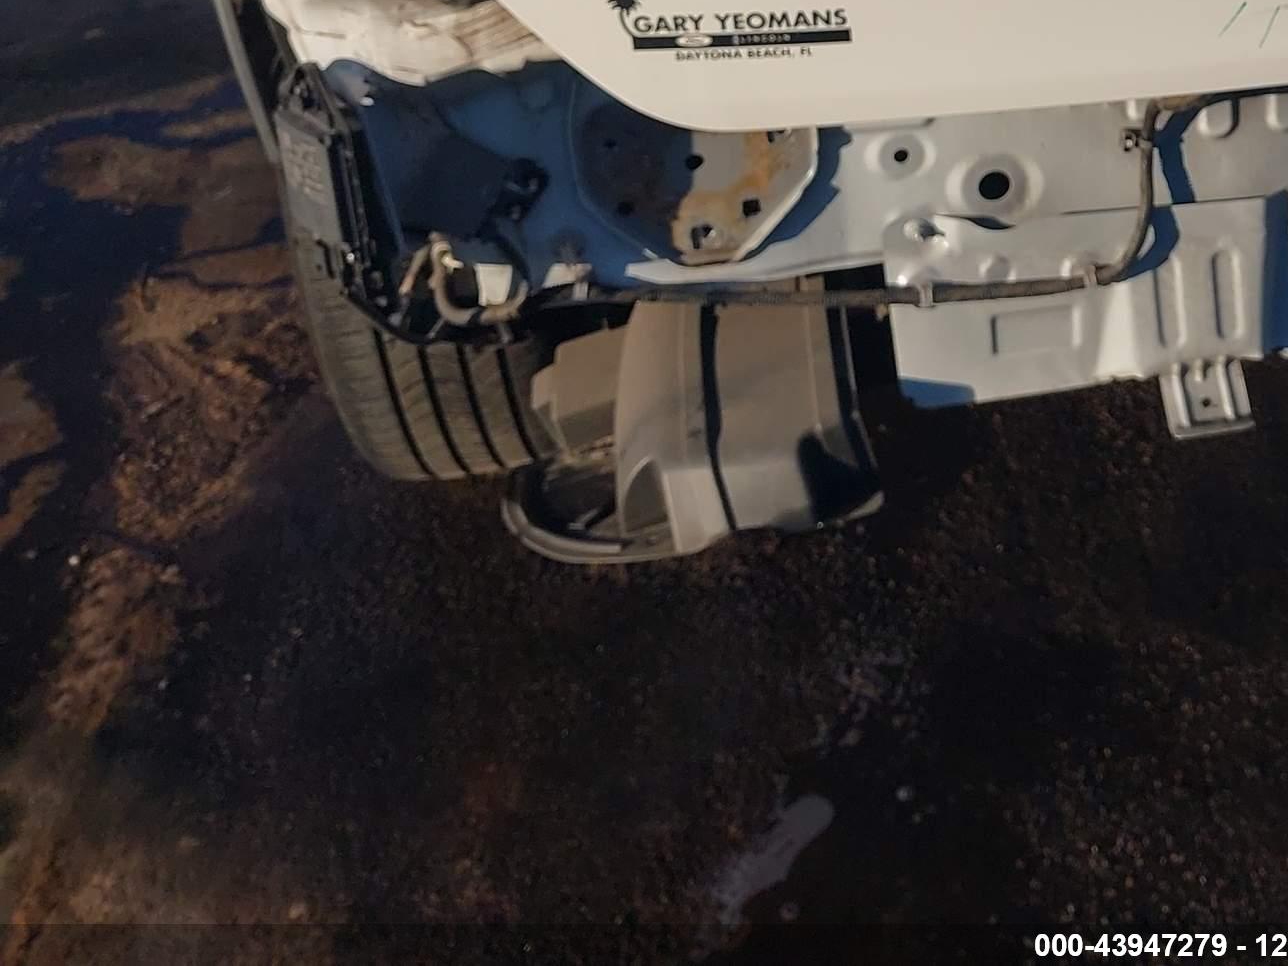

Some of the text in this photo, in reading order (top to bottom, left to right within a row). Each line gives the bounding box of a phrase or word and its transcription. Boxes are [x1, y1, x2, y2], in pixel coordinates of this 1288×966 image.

[633, 9, 847, 33] GARY YEOMANS
[676, 49, 742, 61] DAYTONA
